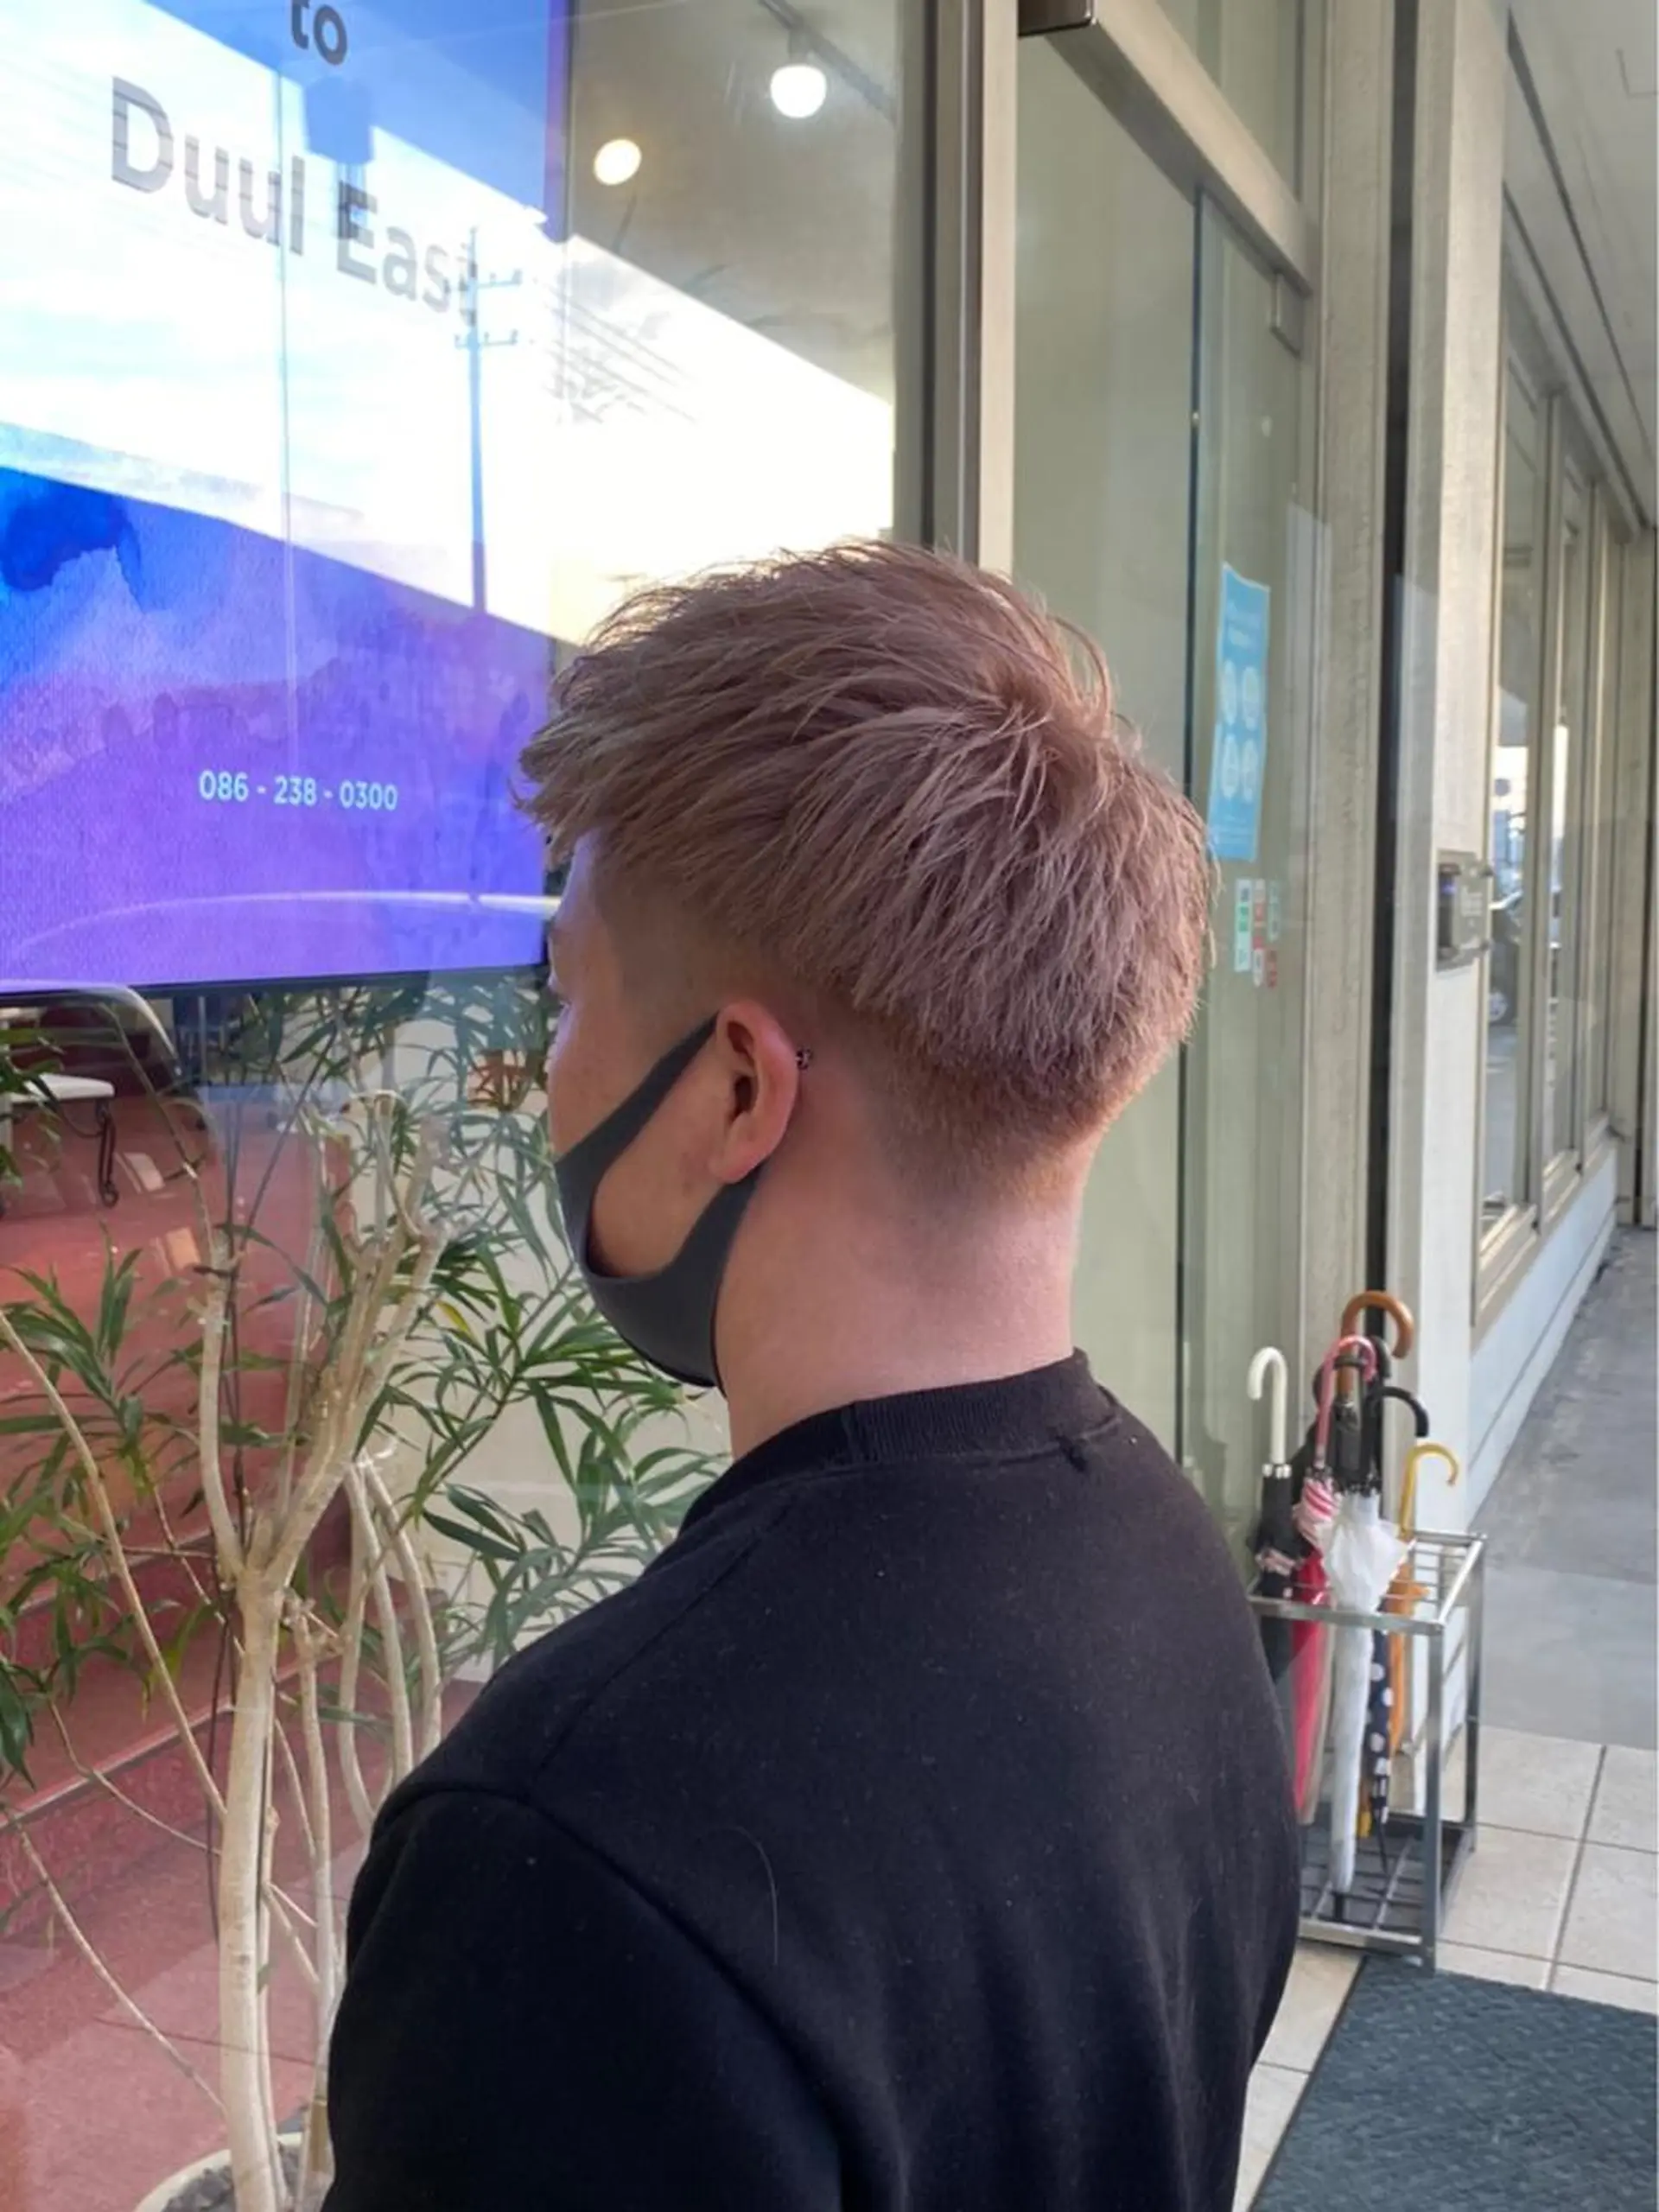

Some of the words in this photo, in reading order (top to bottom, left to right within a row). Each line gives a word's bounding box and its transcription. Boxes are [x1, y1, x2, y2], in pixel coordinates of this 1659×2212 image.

[290, 0, 348, 66] to
[111, 75, 305, 257] Duul
[199, 770, 249, 802] 086
[273, 775, 318, 806] 238
[338, 779, 398, 810] 0300
